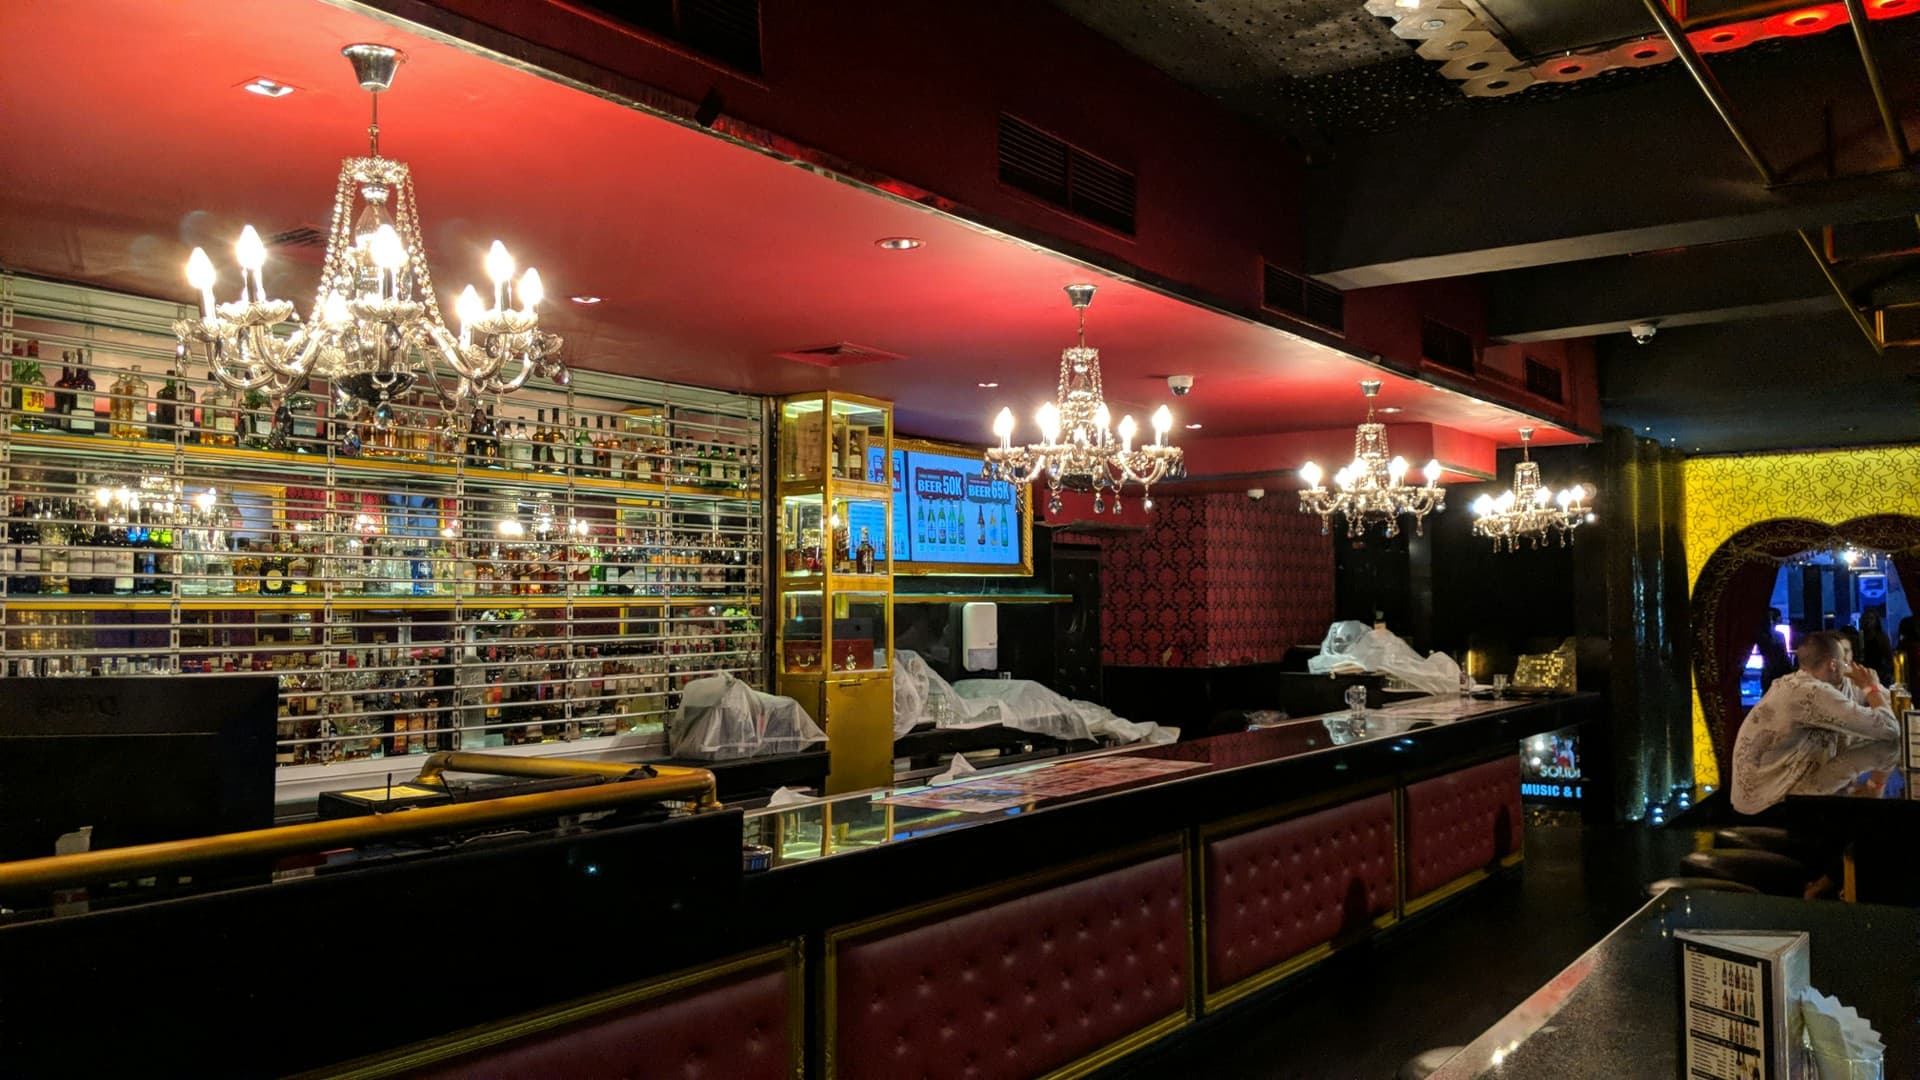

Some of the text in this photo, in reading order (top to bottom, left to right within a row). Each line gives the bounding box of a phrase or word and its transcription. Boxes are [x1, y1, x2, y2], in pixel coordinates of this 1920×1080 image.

[918, 480, 942, 493] BEER
[943, 476, 962, 495] 50K
[969, 480, 1009, 499] BEER 65K
[1522, 784, 1560, 797] MUSIC
[1563, 786, 1572, 798] &
